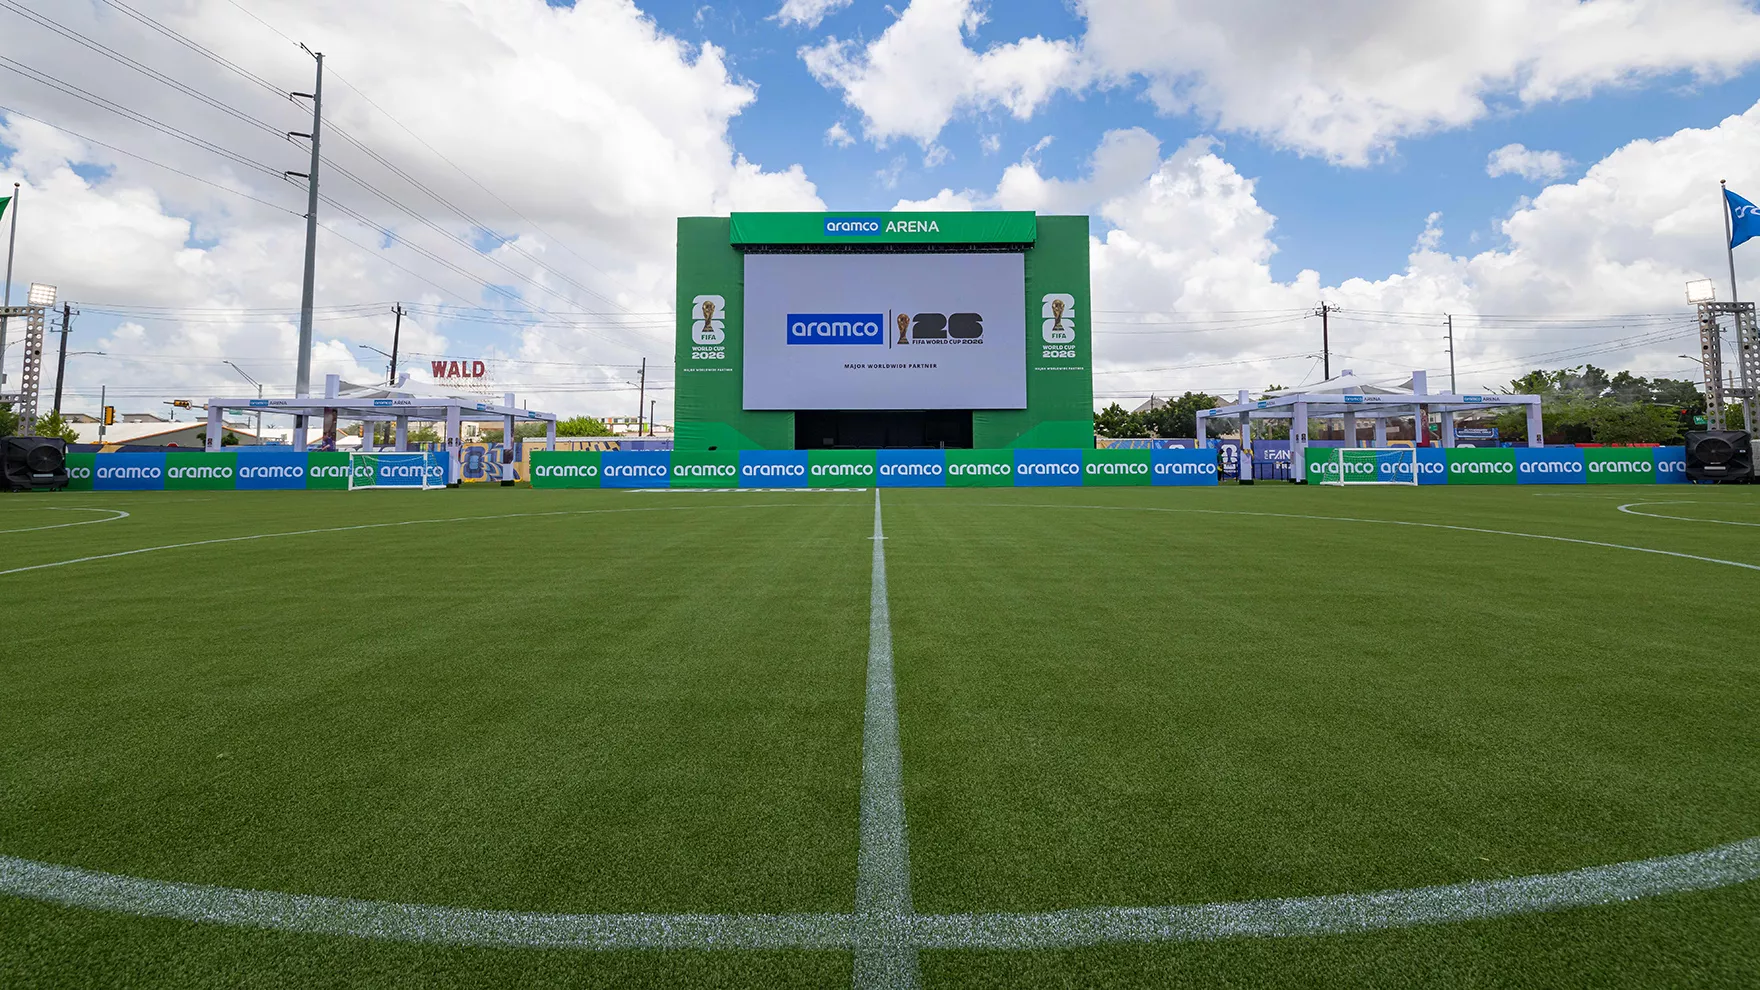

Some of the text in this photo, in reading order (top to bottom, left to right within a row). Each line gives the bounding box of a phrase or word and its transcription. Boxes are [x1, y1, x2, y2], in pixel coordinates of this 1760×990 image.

[826, 221, 940, 232] aramco ARENA
[792, 321, 879, 337] aramco
[1043, 350, 1076, 358] 2026
[431, 361, 485, 378] WALD
[1269, 450, 1291, 459] FAN
[168, 466, 233, 478] aramco
[240, 466, 304, 478] aramco
[535, 465, 598, 477] aramco
[604, 465, 667, 477] aramco
[673, 465, 736, 476] aramco
[743, 464, 805, 476] aramco
[811, 464, 874, 475] aramco
[880, 464, 942, 475] aramco
[949, 464, 1011, 475] aramco
[1017, 463, 1080, 474] aramco
[1086, 463, 1148, 474] aramco
[1154, 463, 1216, 474] aramco
[1450, 462, 1513, 473] aramco
[1519, 461, 1582, 473] aramco
[1588, 461, 1652, 473] aramco
[1658, 461, 1687, 472] ara
[97, 467, 161, 479] aramco
